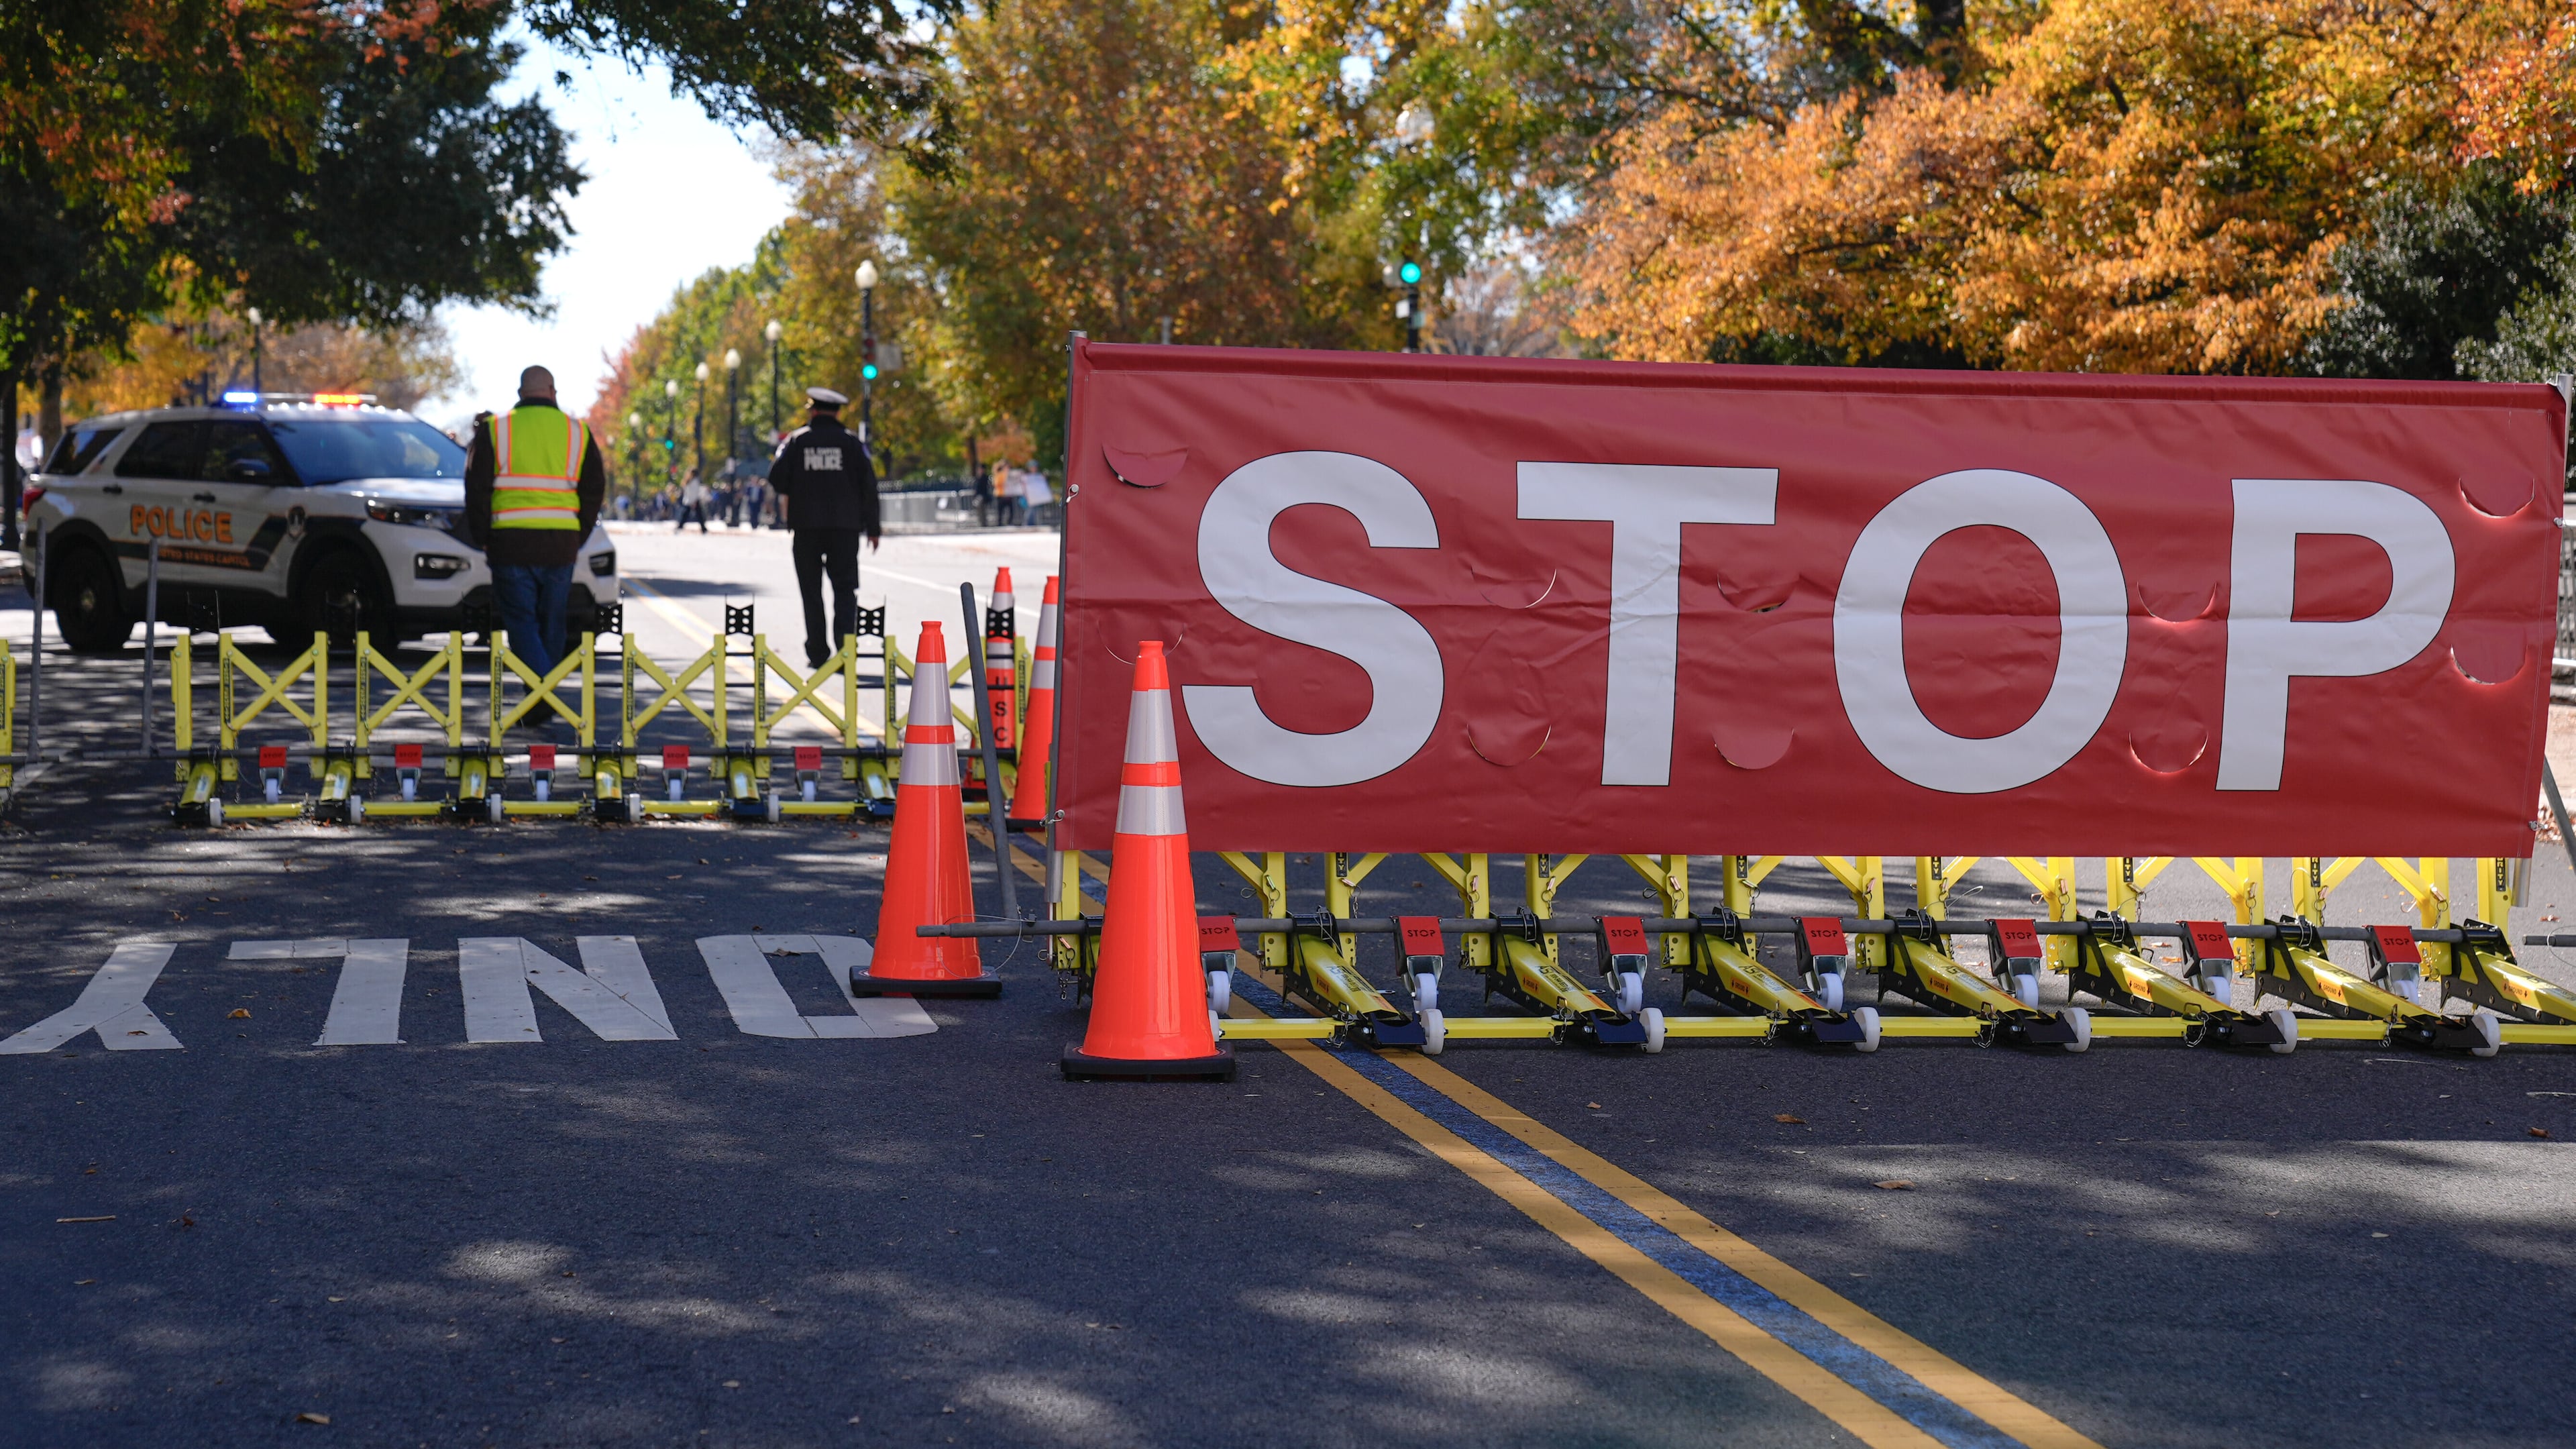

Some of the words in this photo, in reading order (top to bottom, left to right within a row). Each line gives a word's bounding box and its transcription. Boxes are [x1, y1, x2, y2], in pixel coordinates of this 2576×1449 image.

[804, 456, 843, 470] POLICE
[131, 504, 233, 543] POLICE
[1182, 450, 2457, 794] STOP
[1407, 929, 1436, 937] STOP
[1611, 929, 1638, 937] STOP
[2004, 931, 2032, 939] STOP
[1933, 980, 1945, 991] GROUND
[2133, 982, 2146, 992] GROUND
[2323, 984, 2337, 995] GROUND
[2508, 986, 2522, 996] GROUND
[0, 934, 939, 1055] ONLY
